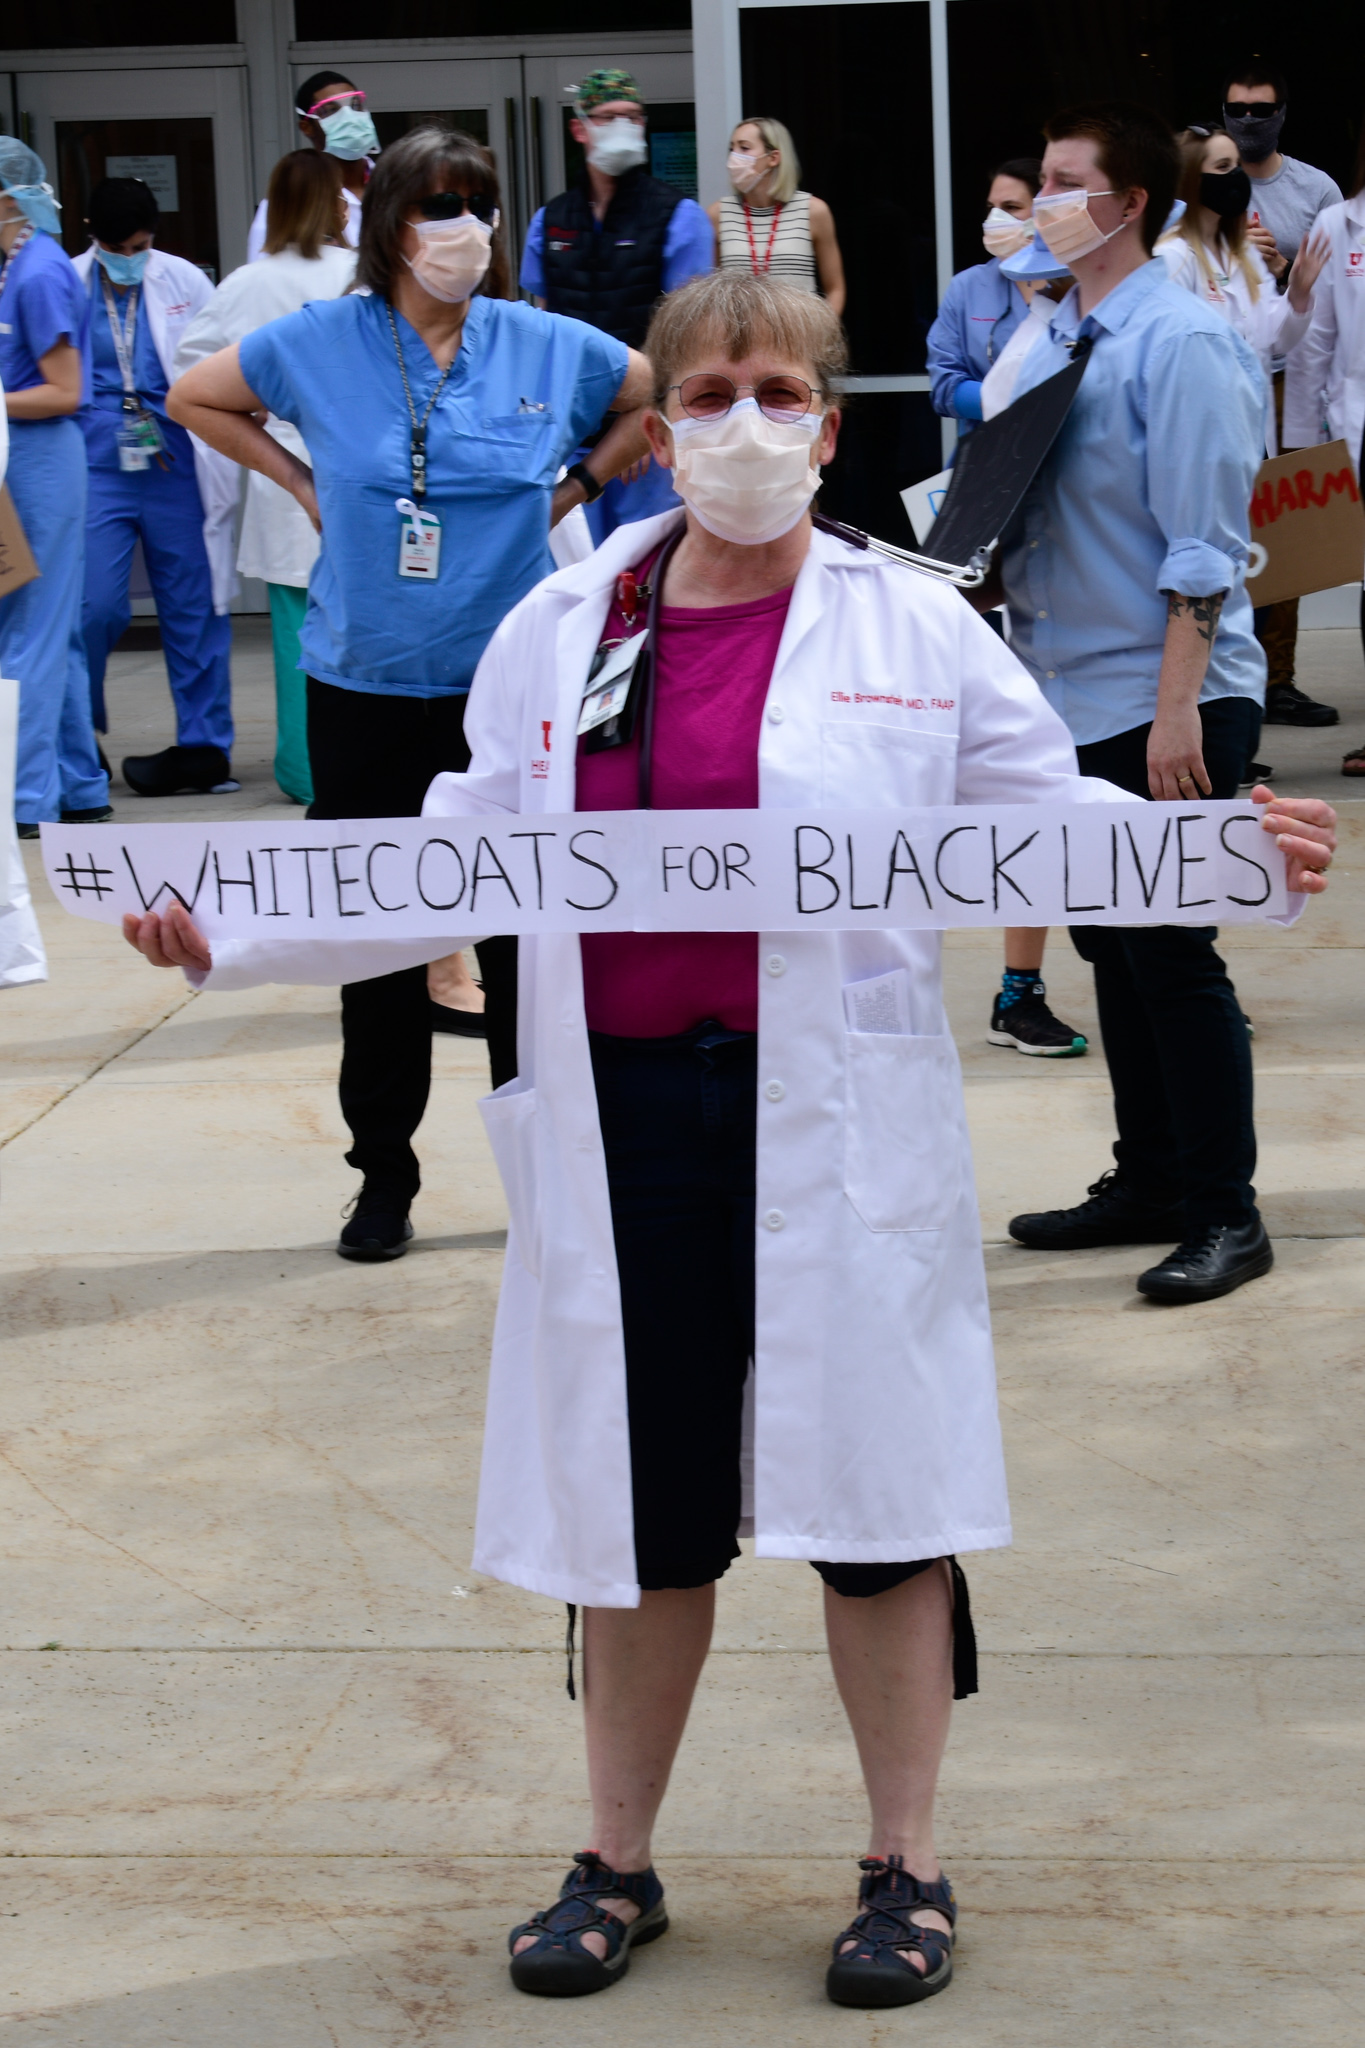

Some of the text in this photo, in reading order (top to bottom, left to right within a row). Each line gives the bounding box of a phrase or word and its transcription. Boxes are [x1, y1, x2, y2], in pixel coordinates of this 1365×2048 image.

[1249, 466, 1360, 529] HARM
[54, 830, 619, 920] #WHITECOATS
[663, 842, 756, 892] FOR
